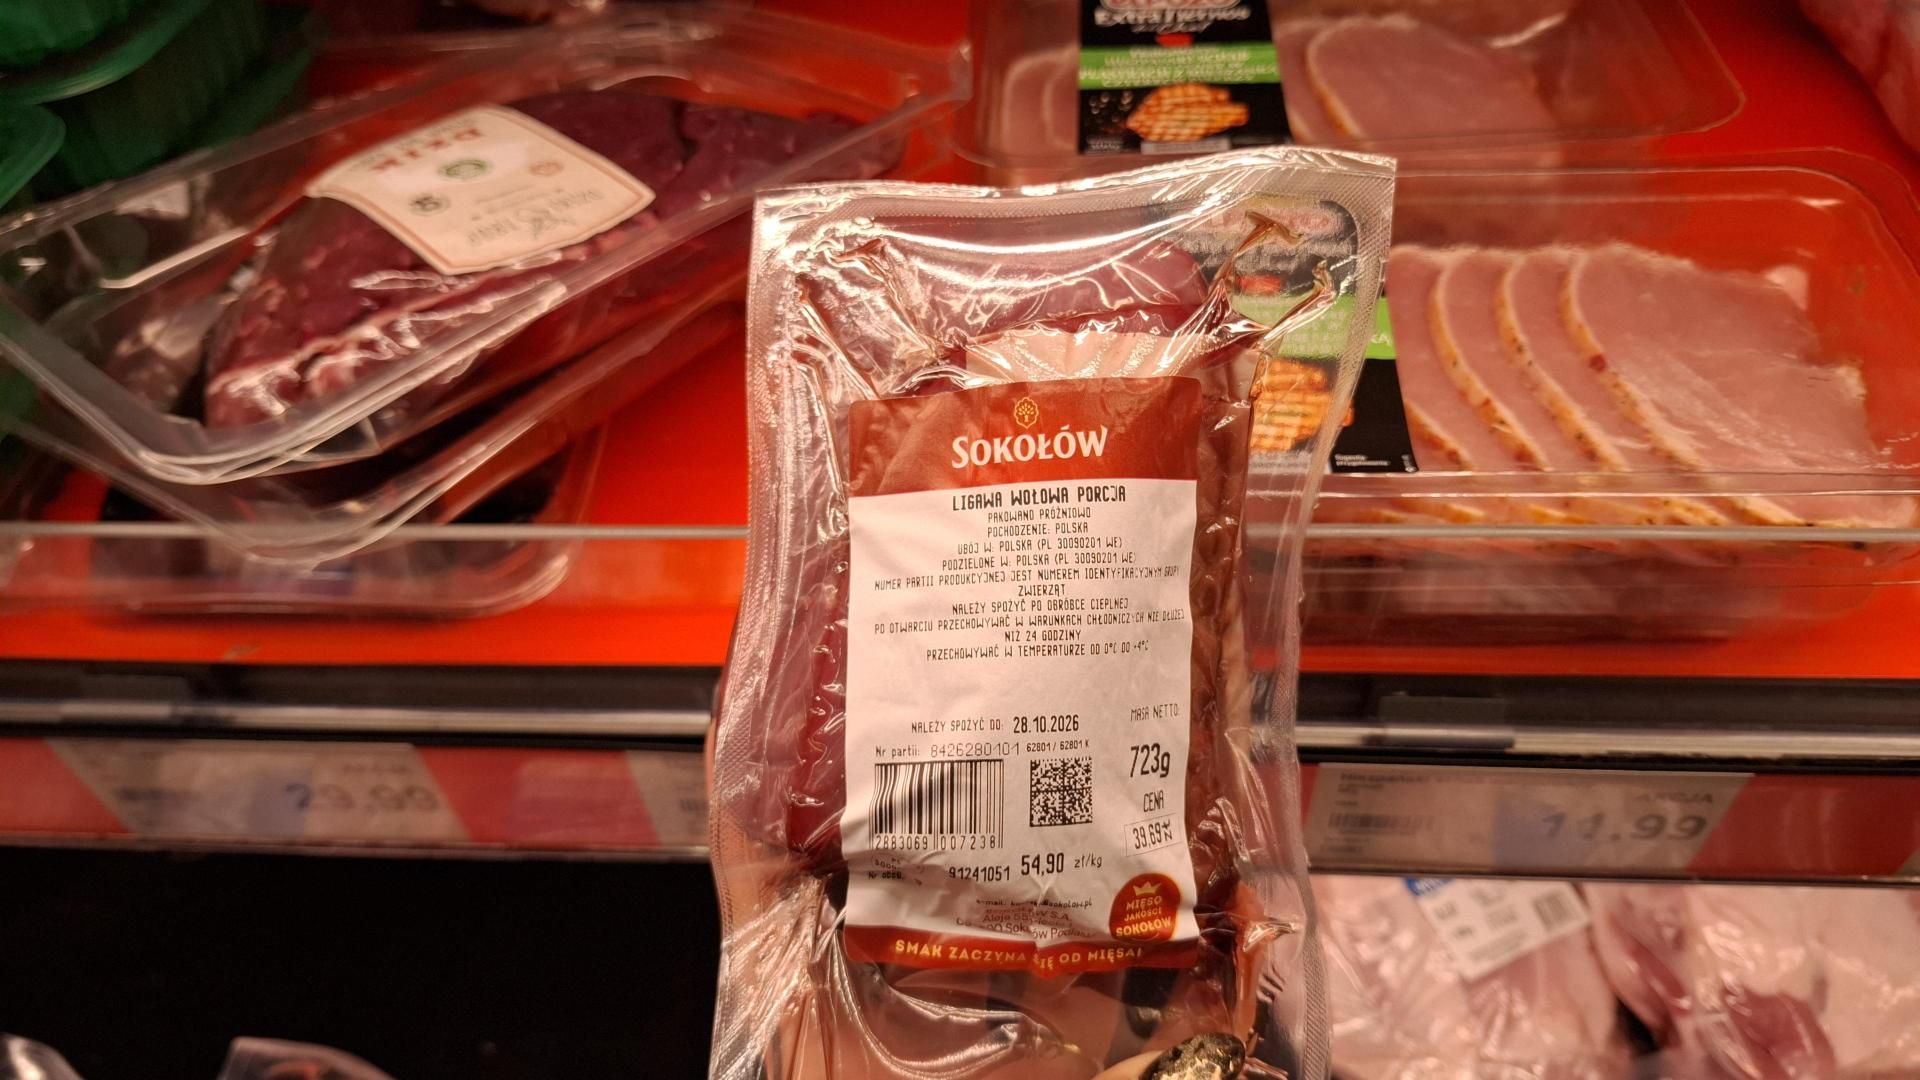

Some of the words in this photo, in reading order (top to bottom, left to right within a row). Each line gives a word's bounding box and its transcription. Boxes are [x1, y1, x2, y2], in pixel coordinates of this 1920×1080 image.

[952, 424, 1108, 470] SOKOŁÓW
[953, 492, 1002, 511] LIGAWA
[1011, 487, 1069, 506] WOŁOWA
[1078, 485, 1126, 502] PORCJA
[988, 509, 1034, 524] PAKOWANO
[1040, 506, 1091, 520] PRÓŻNIOWO
[988, 524, 1050, 538] POCHODZENIE:
[1055, 522, 1089, 534] POLSKA
[958, 543, 979, 555] UBÓJ
[1000, 539, 1032, 552] POLSKA
[1038, 538, 1052, 550] (PL
[1057, 537, 1101, 550] 30090201
[1105, 536, 1123, 548] WE)
[942, 558, 996, 571] PODZIELONE
[1016, 554, 1050, 567] POLSKA
[1054, 552, 1070, 565] (PL
[1074, 552, 1118, 564] 30090201
[874, 578, 902, 591] NUMER
[906, 575, 934, 588] PARTII
[939, 572, 1006, 586] PRODUKCYJNEJ
[1010, 570, 1032, 583] JEST
[1038, 568, 1080, 581] NUMEREM
[1018, 583, 1066, 598] ZWIERZĄT
[952, 602, 986, 616] NALEŻY
[991, 598, 1026, 613] SPOŻYĆ
[1032, 600, 1042, 612] PO
[1047, 598, 1085, 611] OBRÓBCE
[1090, 597, 1129, 610] CIEPLNEJ
[874, 623, 885, 635] PO
[890, 620, 933, 634] OTWARCIU
[938, 614, 1010, 632] PRZECHOWYWAĆ
[1015, 617, 1024, 627] W
[1029, 614, 1082, 627] WARUNKACH
[1148, 610, 1159, 623] NIE
[1005, 630, 1021, 642] NIŻ
[1026, 630, 1037, 642] 24
[1042, 629, 1082, 641] GODZINY
[926, 644, 999, 661] PRZECHOWYWAĆ
[1005, 647, 1013, 658] W
[1018, 644, 1086, 657] TEMPERATURZE
[1090, 643, 1100, 655] OD
[1121, 641, 1131, 653] DO
[1130, 706, 1150, 722] MASA
[912, 720, 946, 734] NALEŻY
[950, 717, 985, 732] SPOŻYĆ
[990, 718, 1004, 731] DO:
[1013, 714, 1080, 734] 28.10.2026
[876, 746, 886, 758] Nr
[892, 745, 920, 759] partii:
[930, 742, 1020, 758] 8426280101
[1130, 742, 1171, 778] 723g
[1143, 790, 1165, 812] CENA
[875, 835, 928, 850] 2883069
[940, 835, 996, 850] 007238
[1132, 822, 1162, 850] 39,69
[1021, 852, 1065, 876] 54,90
[949, 866, 1010, 882] 91241051
[1126, 896, 1162, 911] MIĘSO
[1116, 916, 1172, 937] SOKOŁÓW
[895, 940, 942, 958] SMAK
[949, 946, 1026, 962] ZACZYNA
[1059, 952, 1081, 964] OD
